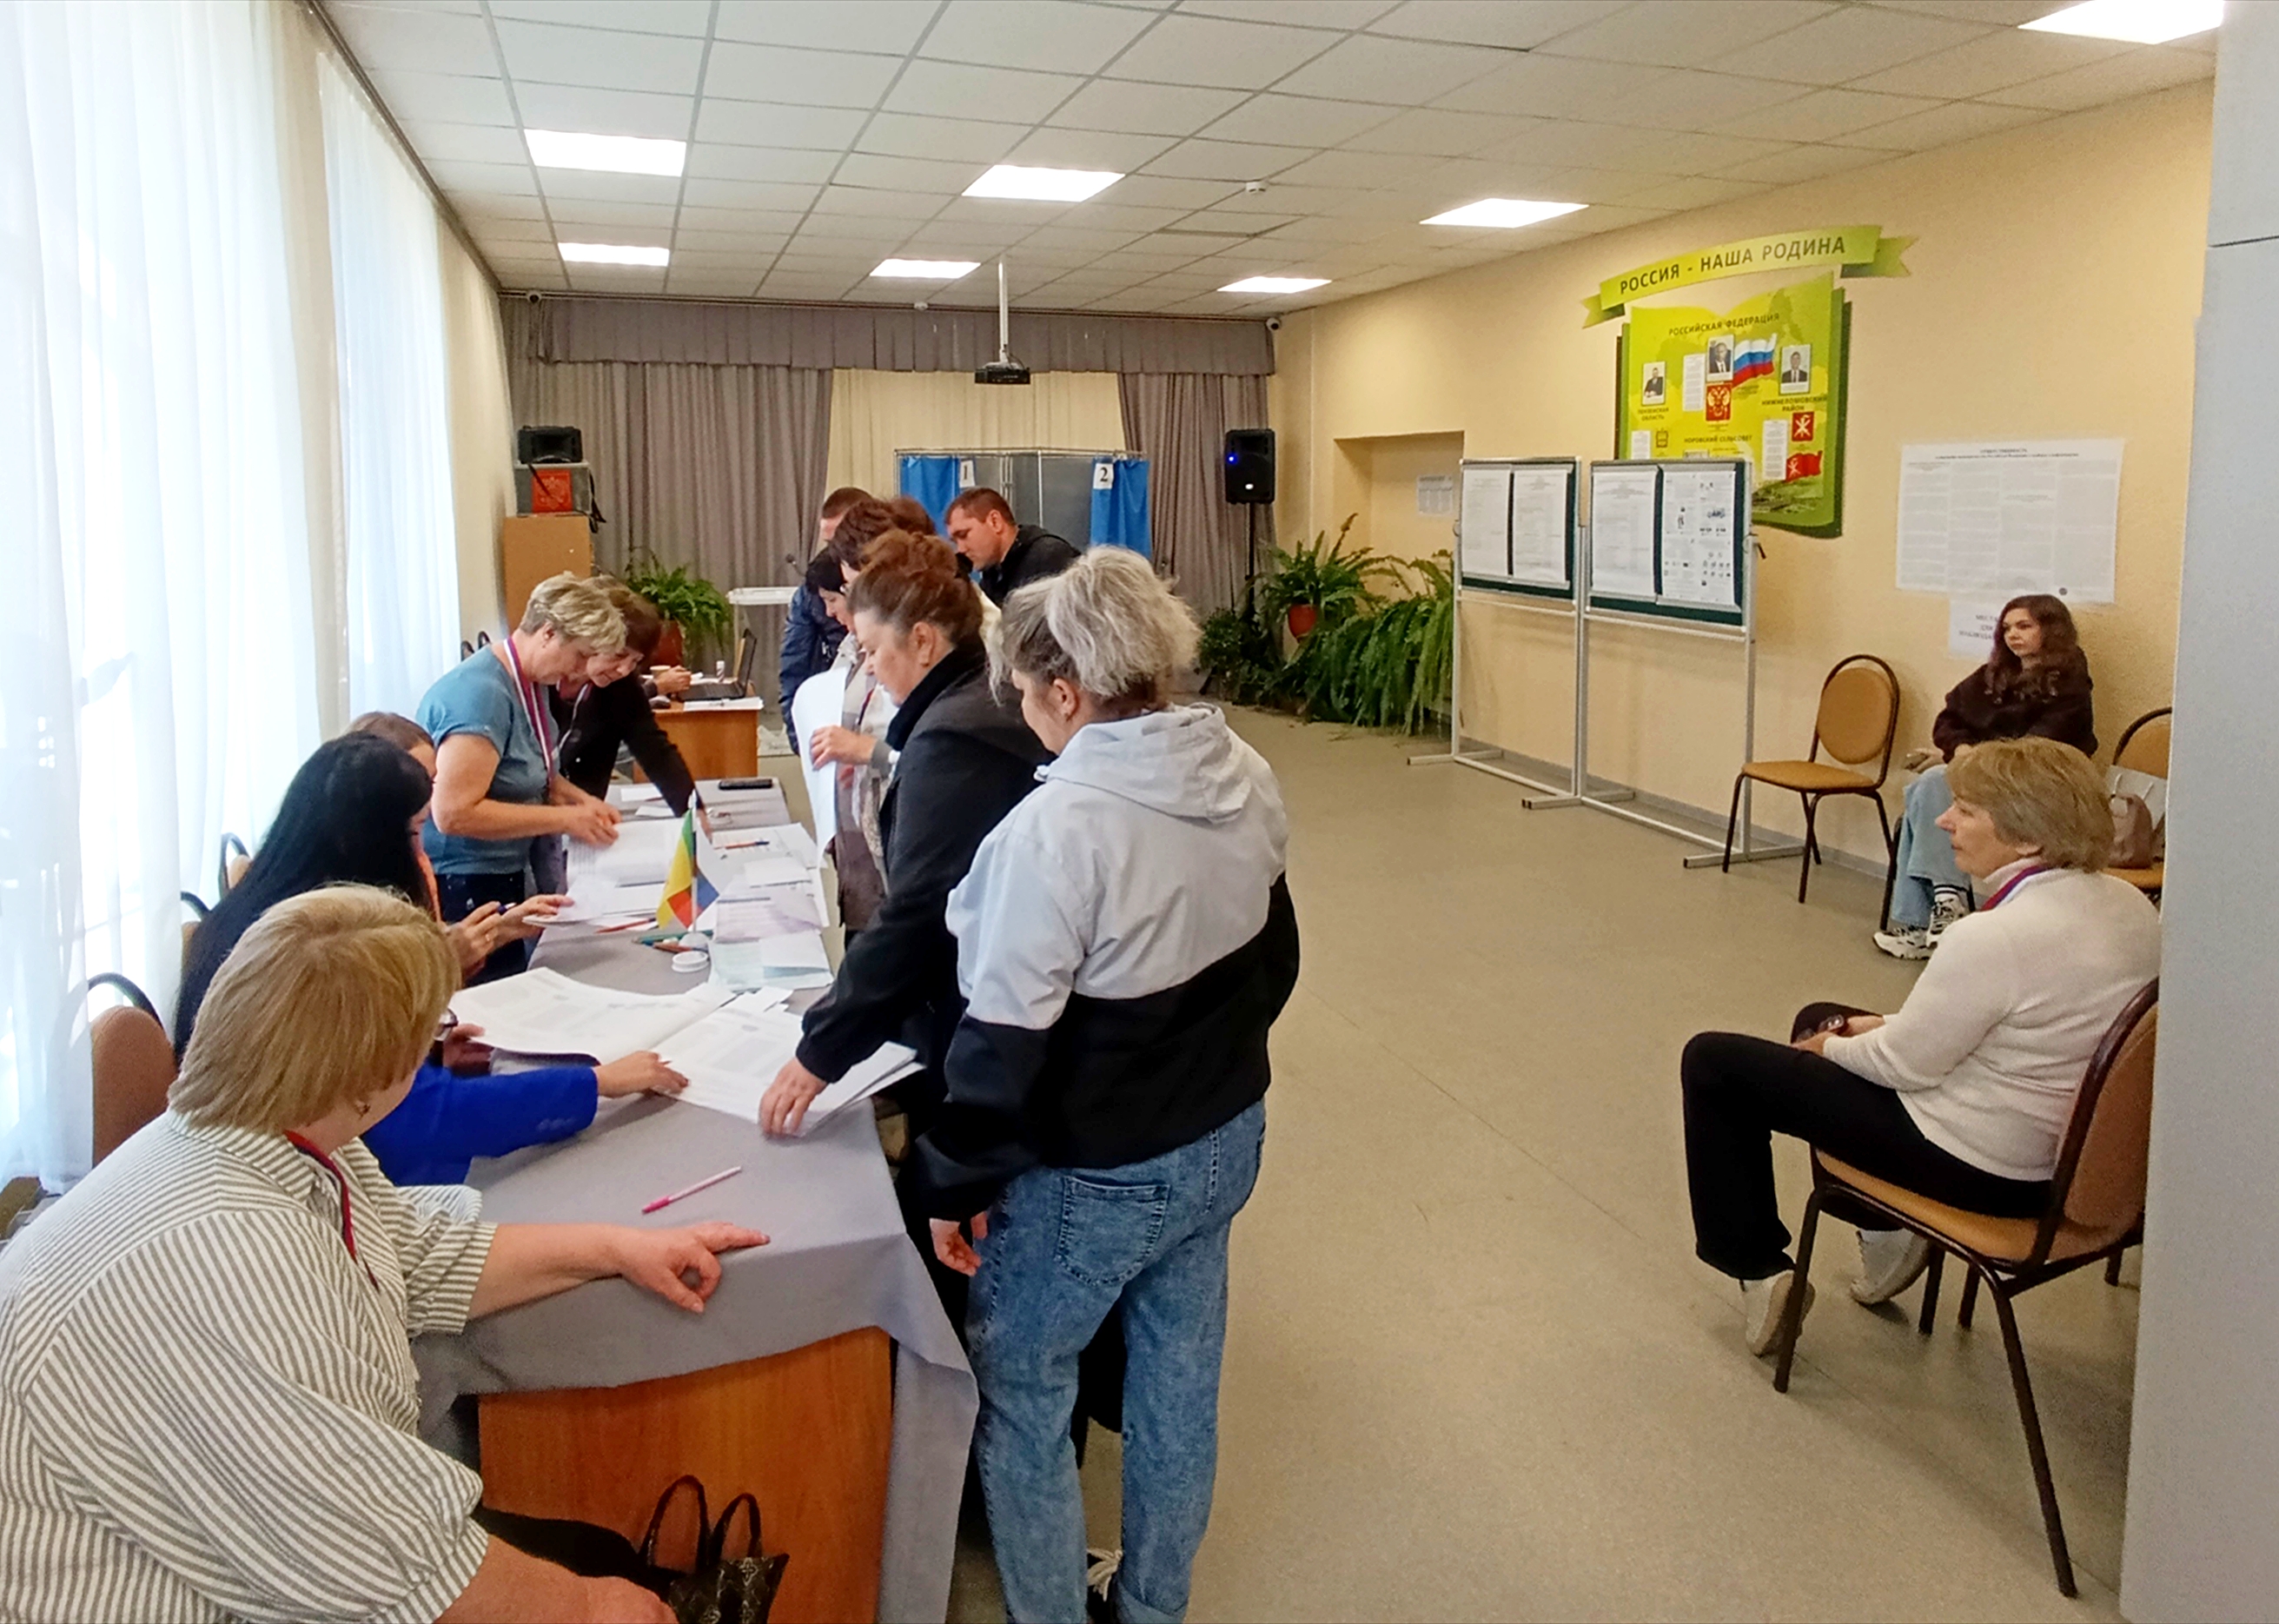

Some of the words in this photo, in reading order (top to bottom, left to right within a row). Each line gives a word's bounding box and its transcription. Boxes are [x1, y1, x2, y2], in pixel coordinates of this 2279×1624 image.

[1620, 264, 1679, 294] РОССИЯ
[1700, 249, 1753, 273] НАША
[1762, 236, 1845, 261] РОДИНА
[1668, 320, 1722, 336] РОССИЙСКАЯ
[1725, 313, 1779, 328] ФЕДЕРАЦИЯ
[963, 465, 968, 480] 1
[1099, 466, 1109, 482] 2
